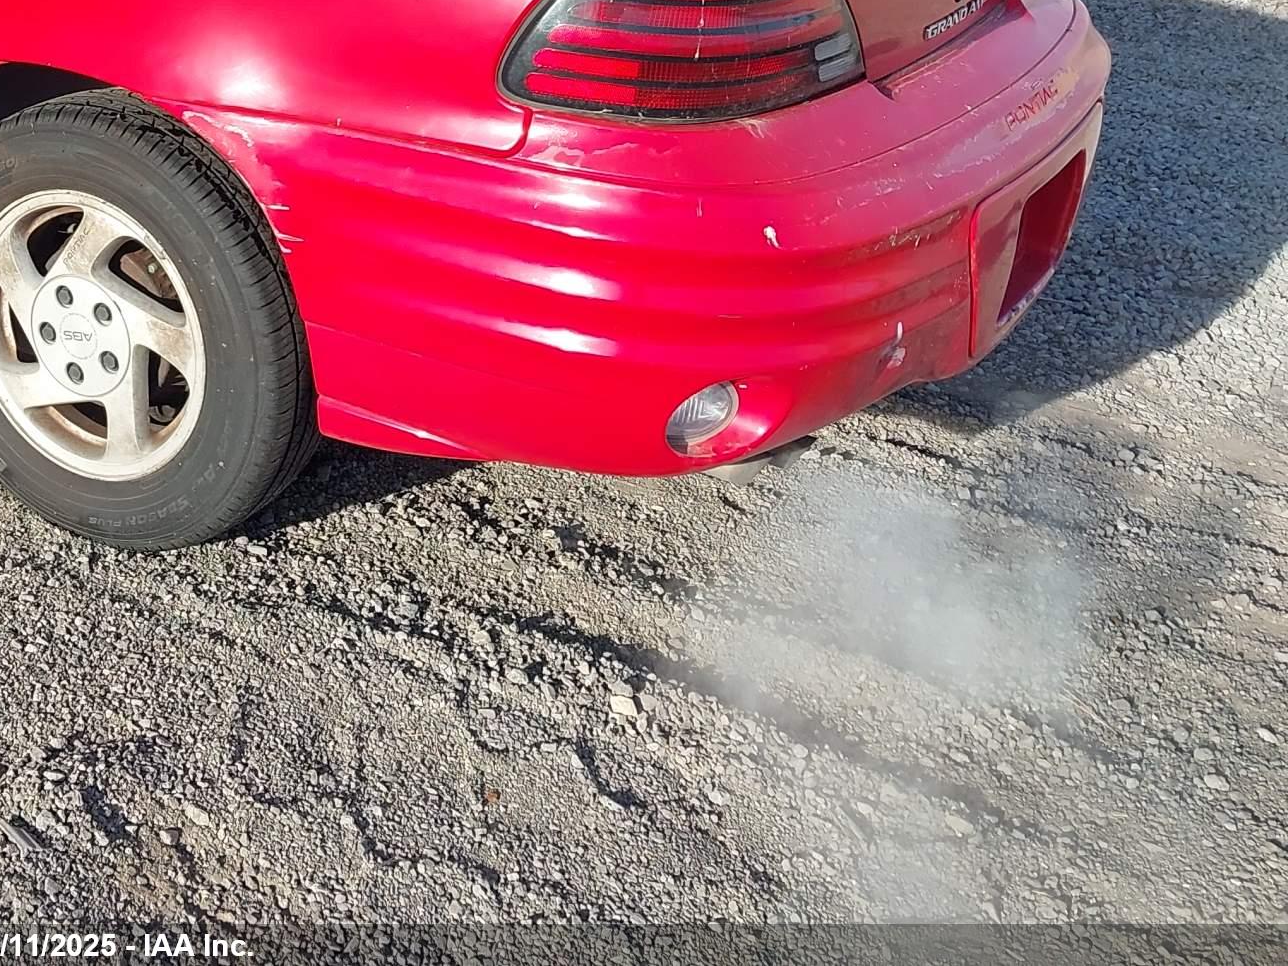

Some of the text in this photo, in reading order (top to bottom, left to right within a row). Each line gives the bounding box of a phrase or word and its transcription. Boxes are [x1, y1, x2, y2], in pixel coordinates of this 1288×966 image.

[925, 5, 969, 39] GRAND
[1004, 79, 1059, 132] PONTIAC
[62, 227, 92, 267] PONTIAC
[63, 330, 93, 342] ABS
